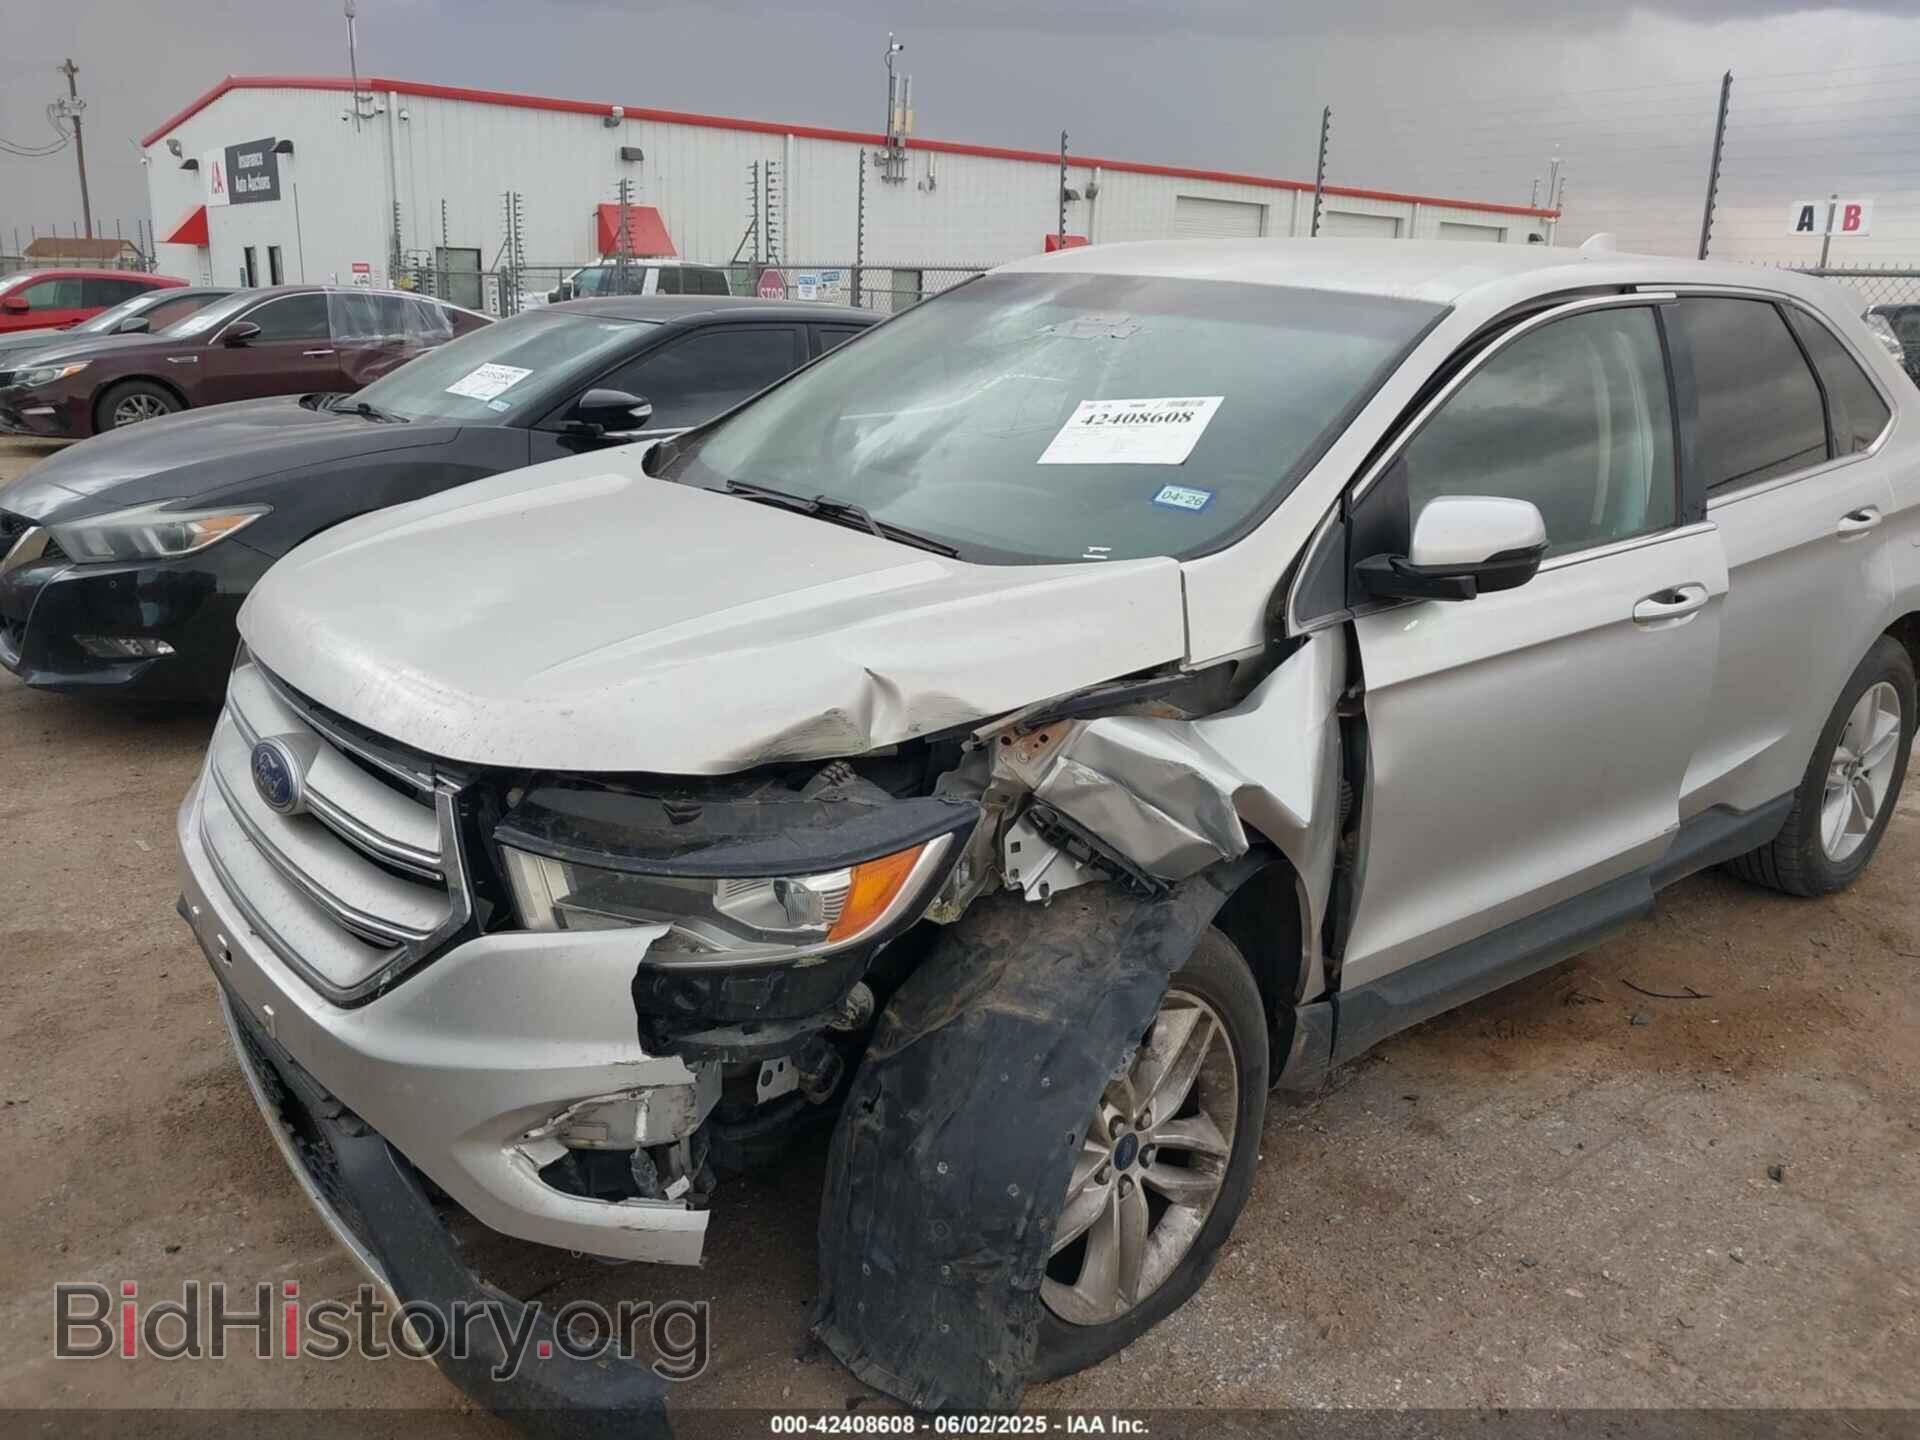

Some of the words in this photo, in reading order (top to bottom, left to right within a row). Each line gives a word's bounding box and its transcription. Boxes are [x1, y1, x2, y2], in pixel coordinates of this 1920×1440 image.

[237, 151, 263, 168] Insurance
[1796, 205, 1814, 231] A
[1842, 204, 1861, 231] B
[761, 288, 784, 300] STOP
[1080, 411, 1195, 425] 42408608
